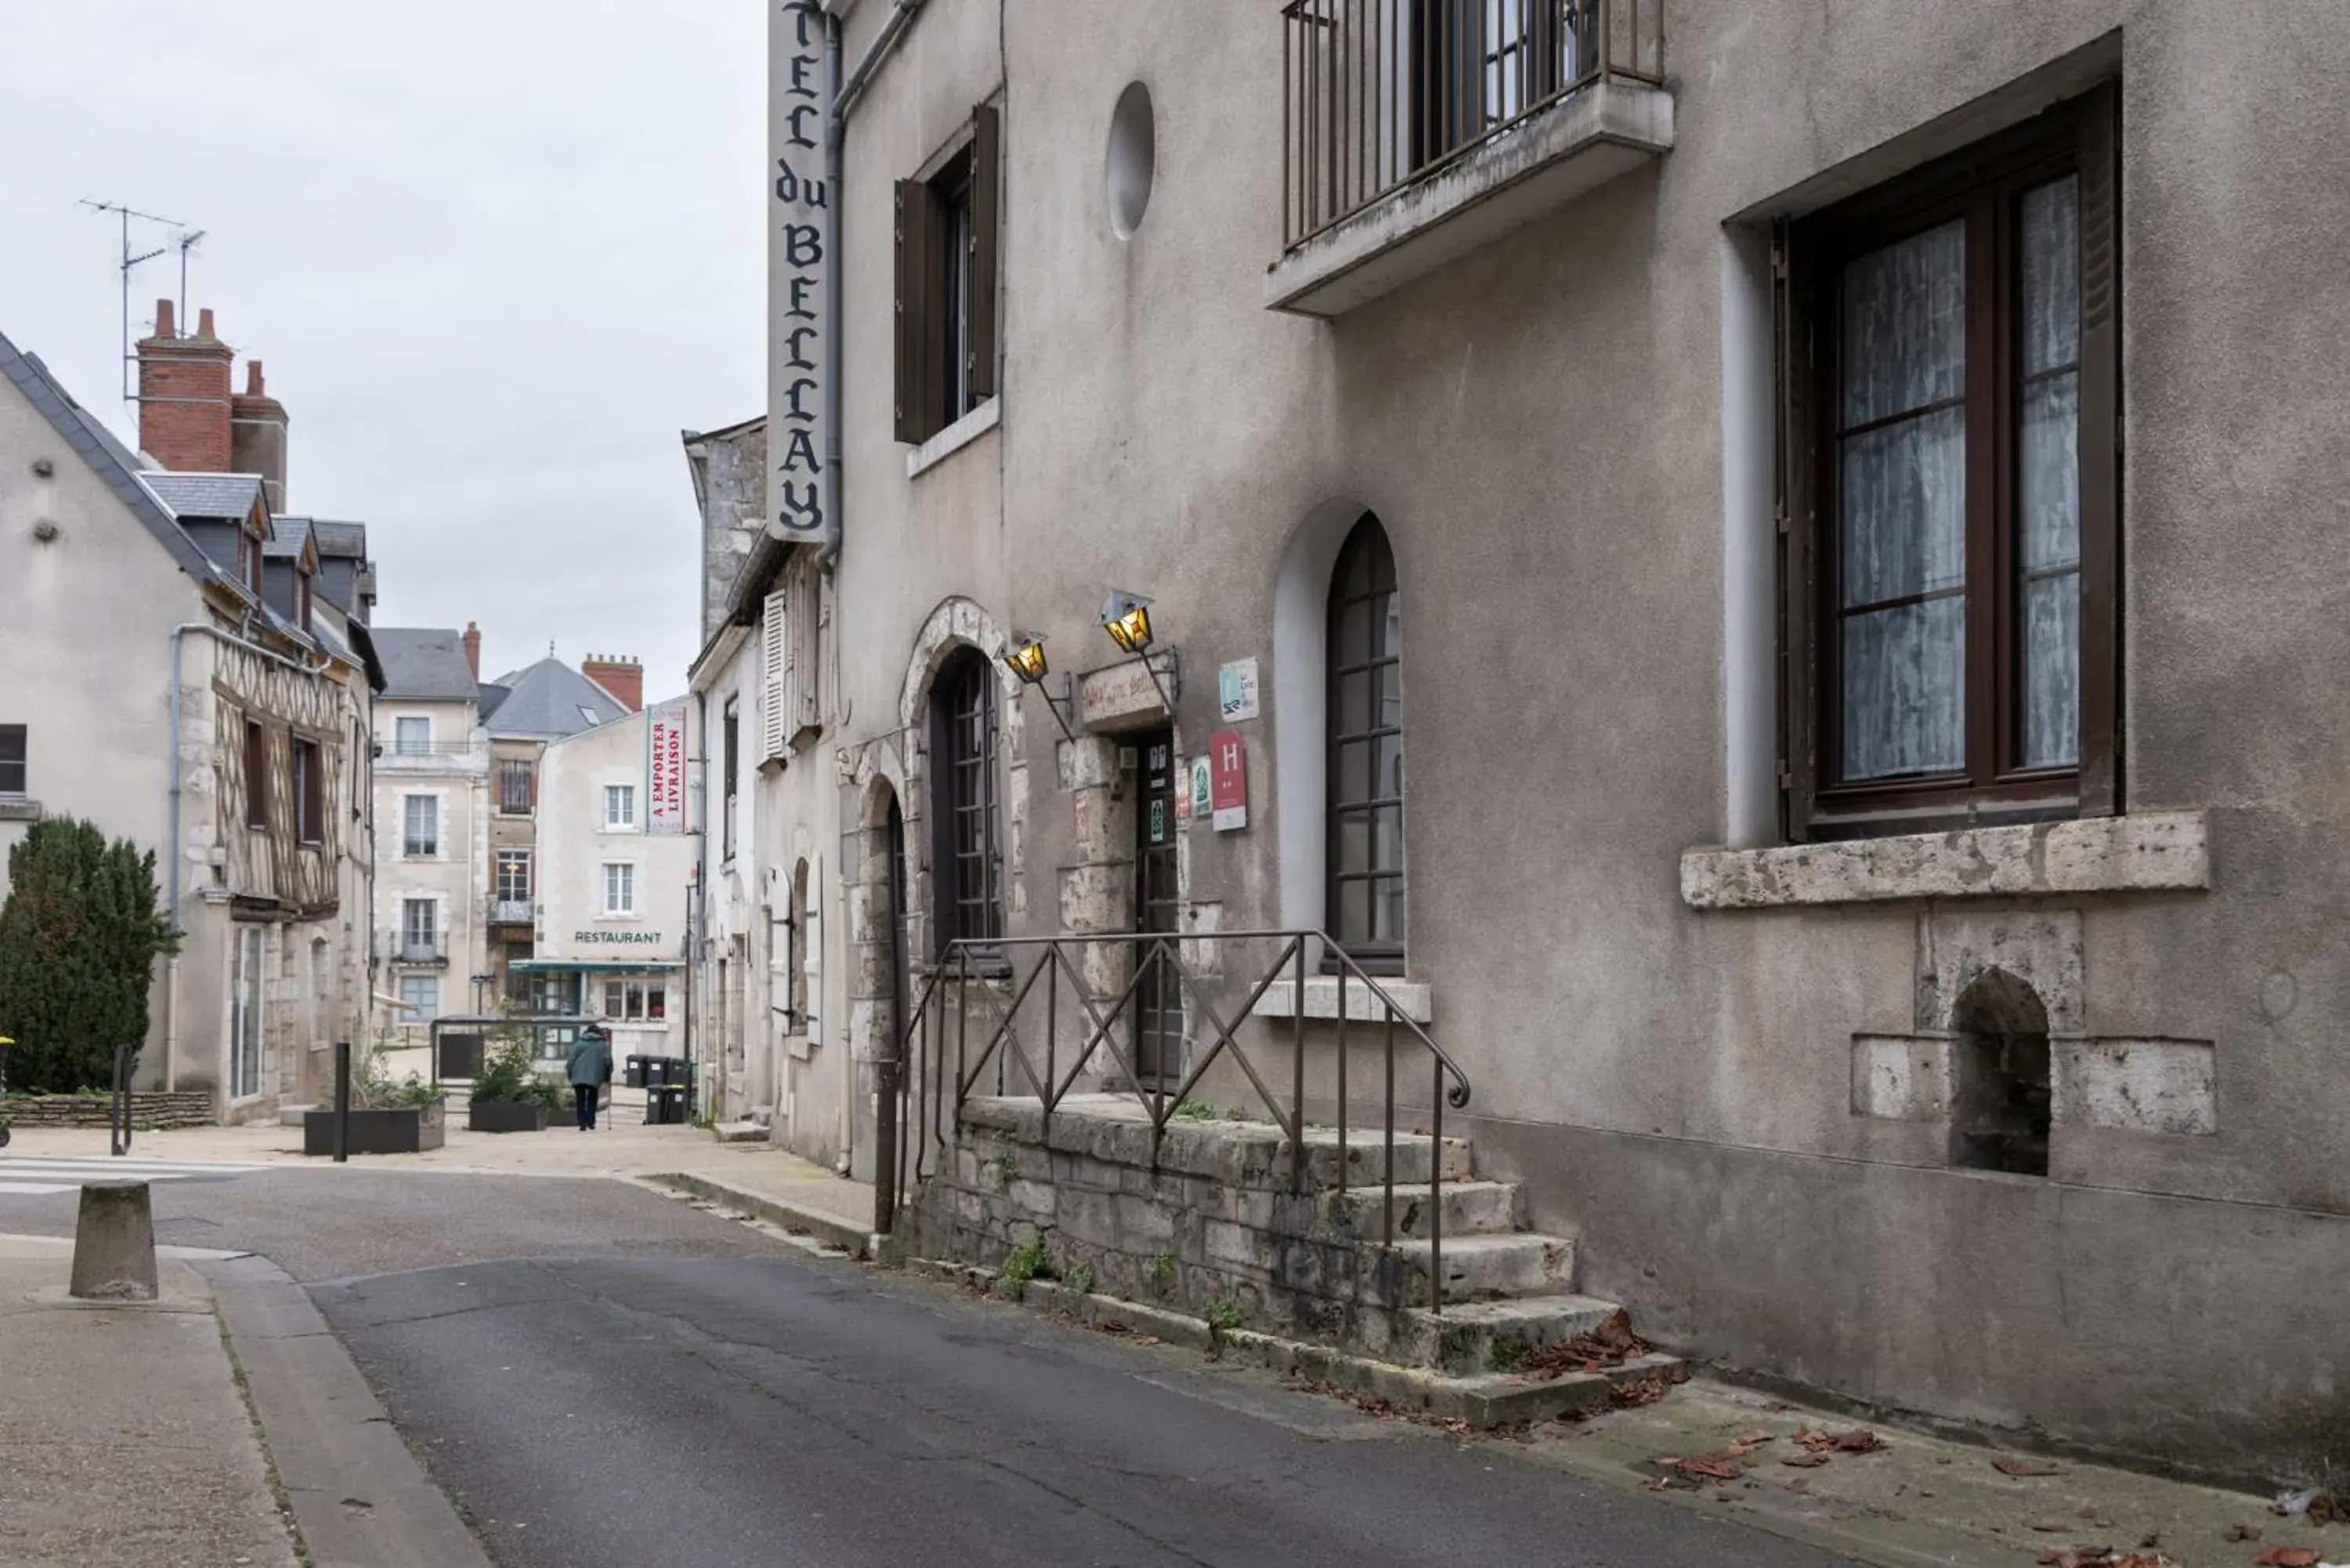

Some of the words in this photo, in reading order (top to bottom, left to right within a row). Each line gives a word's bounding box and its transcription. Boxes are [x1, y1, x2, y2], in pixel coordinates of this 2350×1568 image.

[776, 157, 827, 209] du
[776, 222, 823, 531] BELLAY
[653, 723, 664, 803] EMPORTER
[668, 729, 679, 812] LIVRAISON
[1222, 742, 1238, 772] H
[574, 930, 662, 945] RESTAURANT
